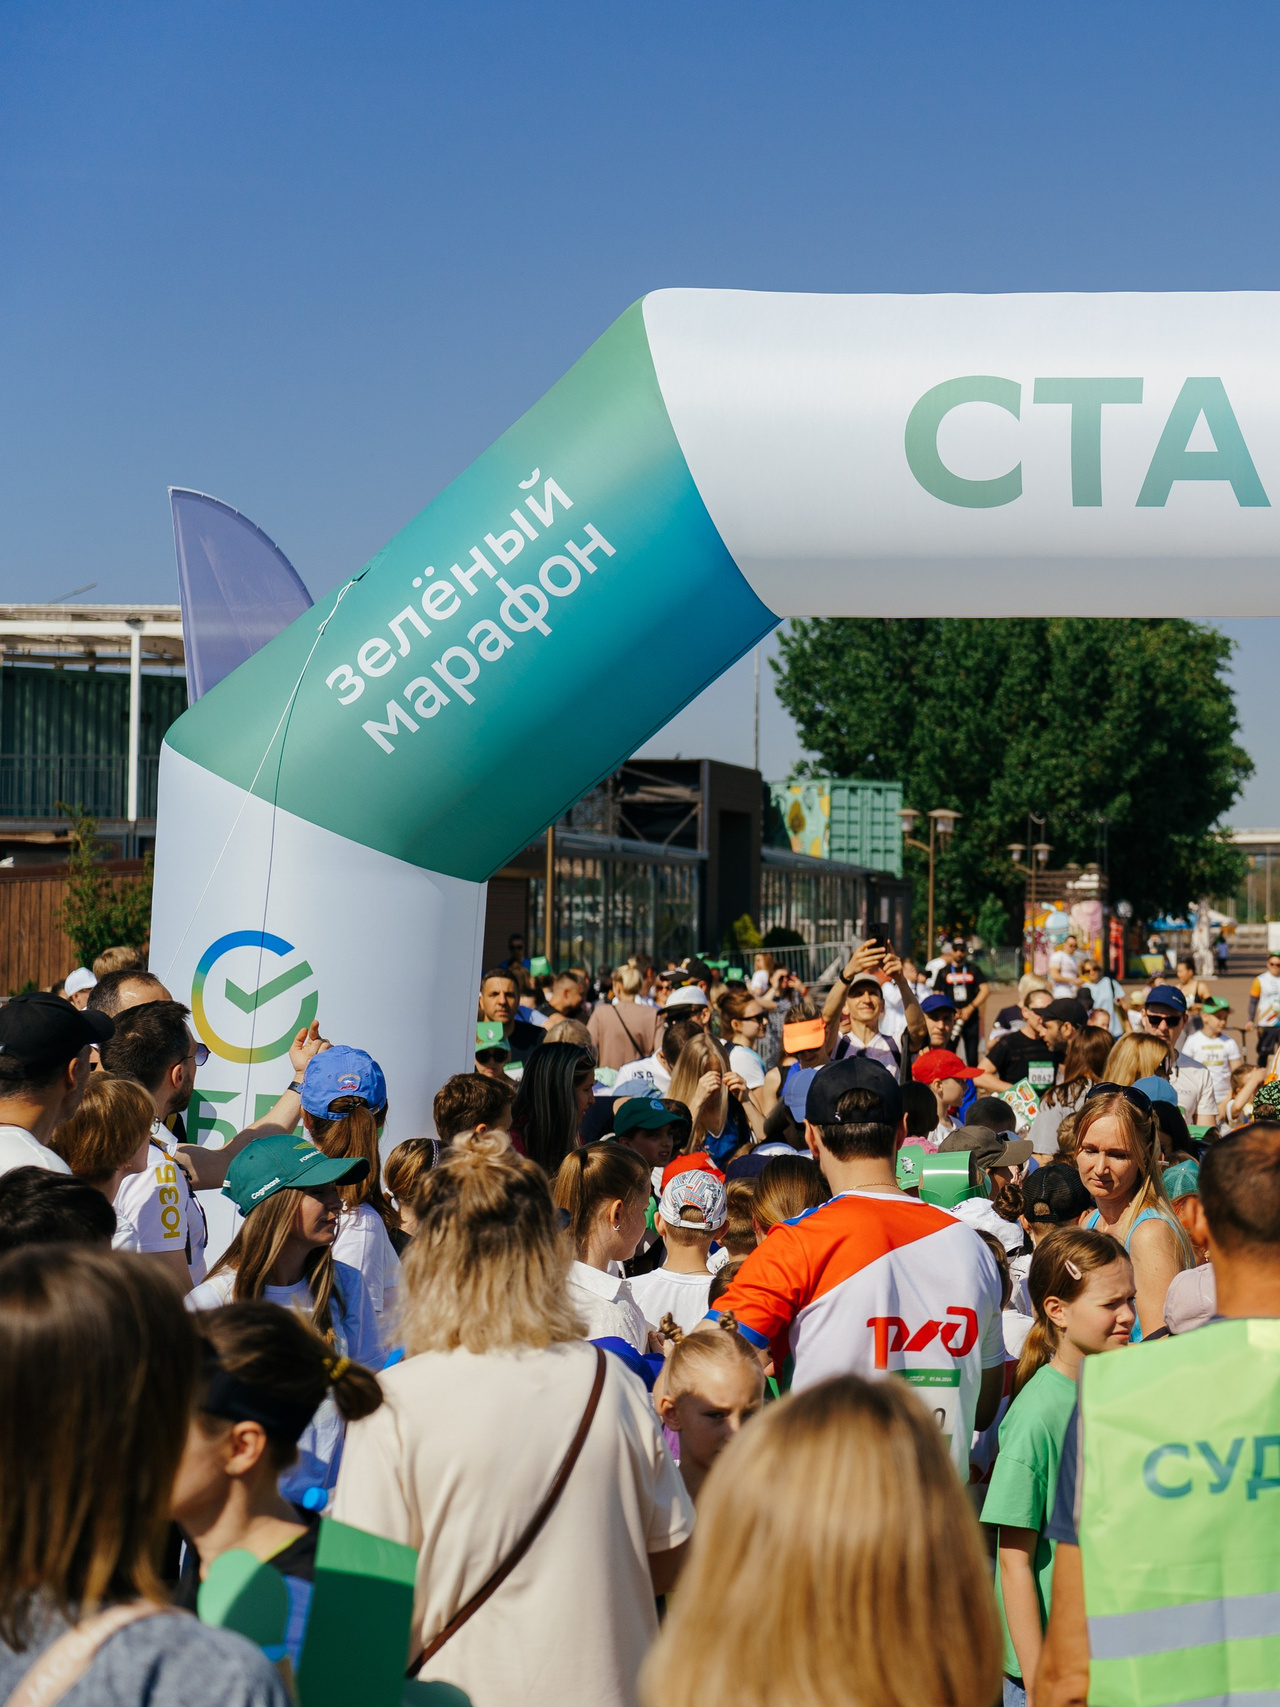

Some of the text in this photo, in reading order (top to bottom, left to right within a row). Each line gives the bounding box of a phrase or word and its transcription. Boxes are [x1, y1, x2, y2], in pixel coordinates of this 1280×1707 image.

[325, 467, 574, 706] зелёный
[361, 522, 617, 755] марафон
[251, 1177, 281, 1200] Cognizant
